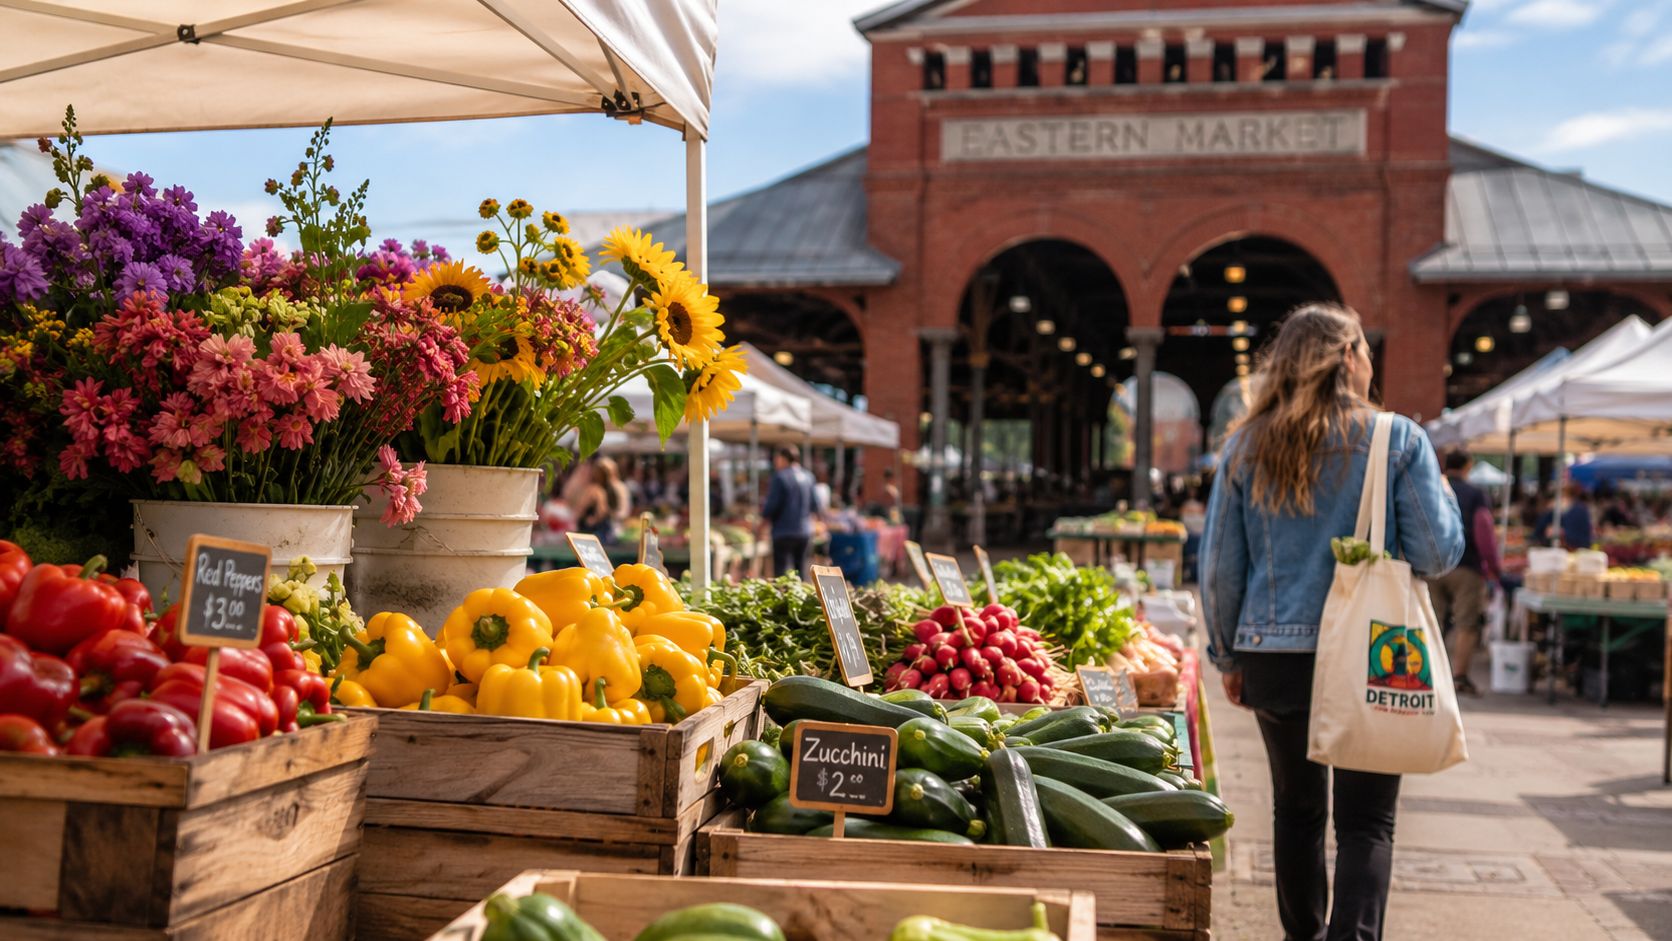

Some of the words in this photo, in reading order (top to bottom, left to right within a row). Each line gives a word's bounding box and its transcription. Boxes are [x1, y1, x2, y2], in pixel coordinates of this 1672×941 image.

[961, 119, 1149, 156] EASTERN
[1175, 115, 1346, 152] MARKET
[197, 552, 222, 587] Red
[224, 559, 263, 597] Peppers
[1366, 689, 1434, 709] DETROIT
[803, 737, 885, 769] Zucchini
